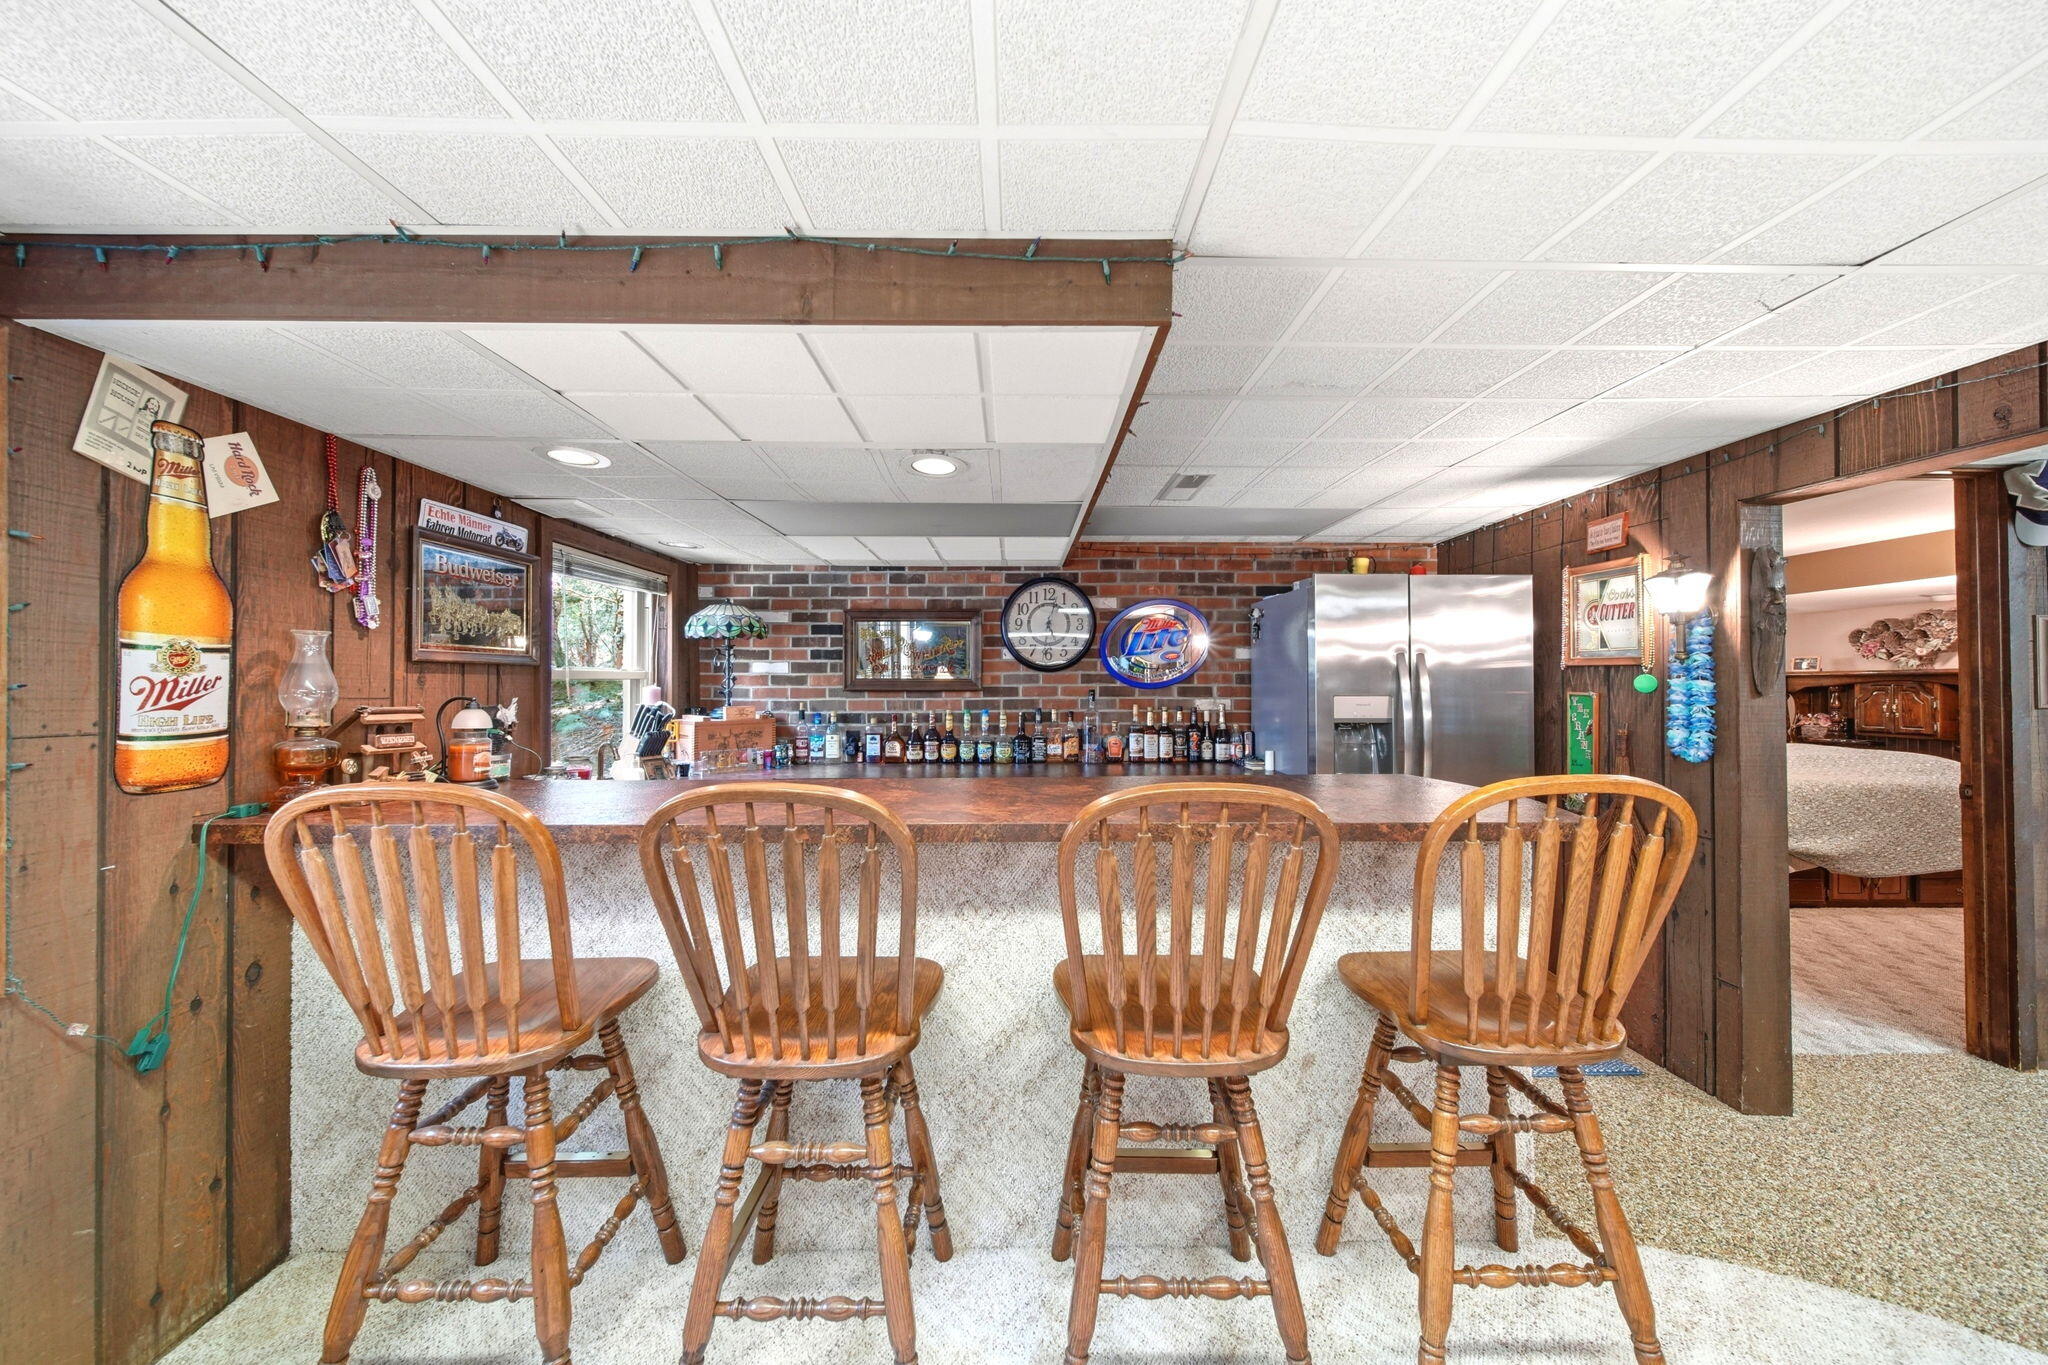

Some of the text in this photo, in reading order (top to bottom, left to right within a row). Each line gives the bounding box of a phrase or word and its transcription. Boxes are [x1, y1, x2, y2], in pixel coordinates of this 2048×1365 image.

[228, 442, 250, 468] Hard
[241, 470, 262, 497] Rock
[427, 506, 493, 533] Echte Männer
[456, 527, 493, 545] Motorrad
[434, 554, 519, 588] Budweiser
[1029, 591, 1039, 604] 11
[1043, 588, 1055, 600] 12
[1017, 603, 1029, 615] 10
[1599, 602, 1635, 621] CUTTER
[1015, 618, 1023, 630] 9
[1076, 618, 1084, 631] 3
[1123, 628, 1190, 656] Lite
[1044, 648, 1052, 660] 6
[129, 675, 222, 712] Miller
[137, 715, 178, 728] HIGH
[183, 714, 215, 726] LIFE
